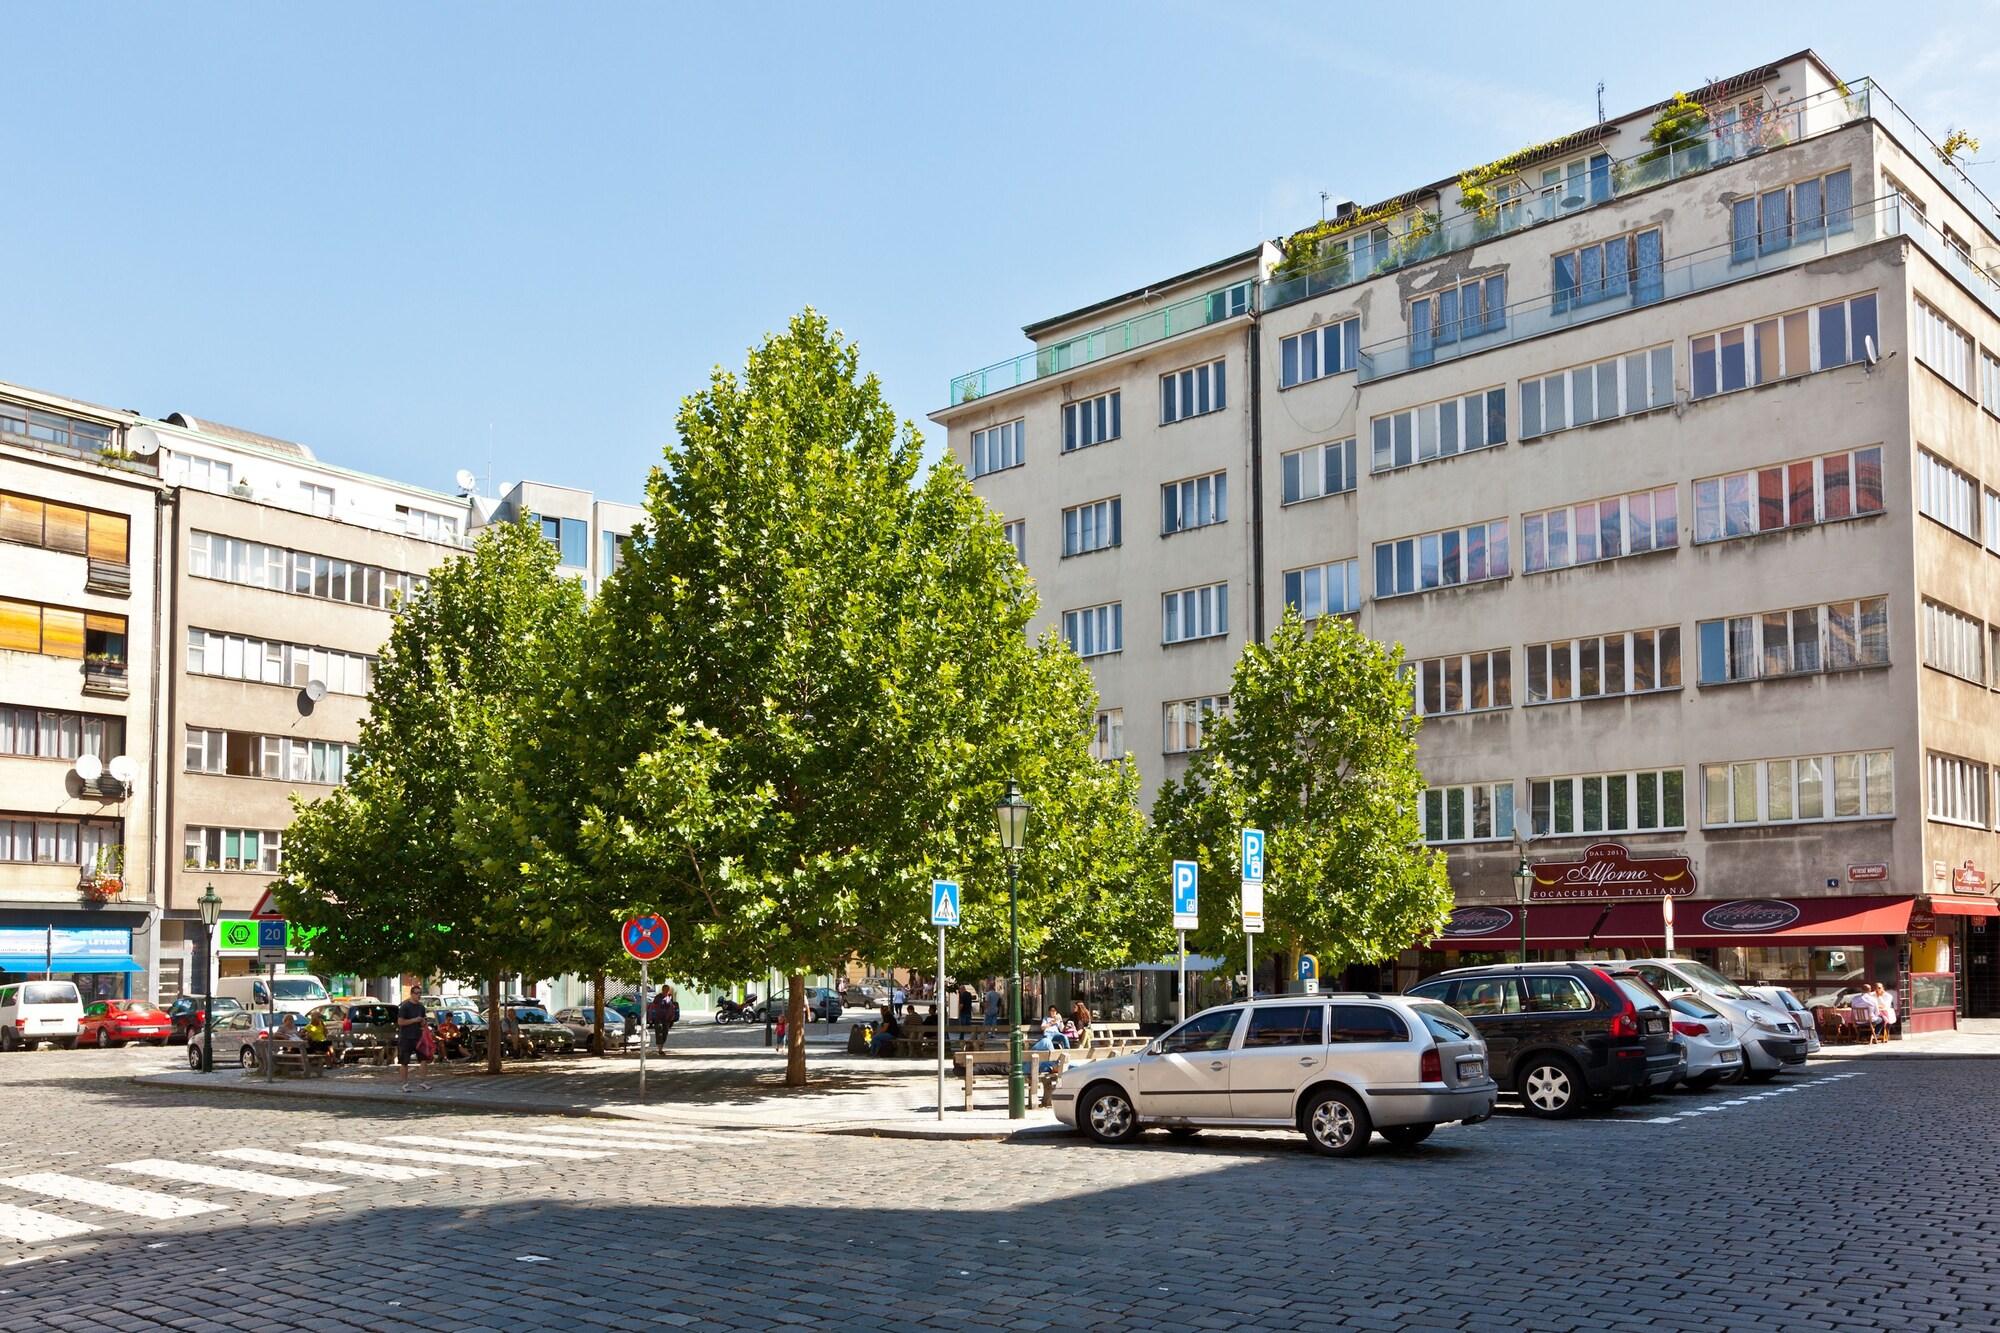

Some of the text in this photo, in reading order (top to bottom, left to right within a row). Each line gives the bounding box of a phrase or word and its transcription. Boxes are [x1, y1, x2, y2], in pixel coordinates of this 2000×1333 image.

[1246, 836, 1259, 865] P
[1566, 861, 1649, 886] Alforno
[1178, 867, 1193, 899] P
[1533, 887, 1686, 898] FOCACCERIA ITALIANA
[265, 928, 280, 940] 20
[1301, 961, 1310, 973] P
